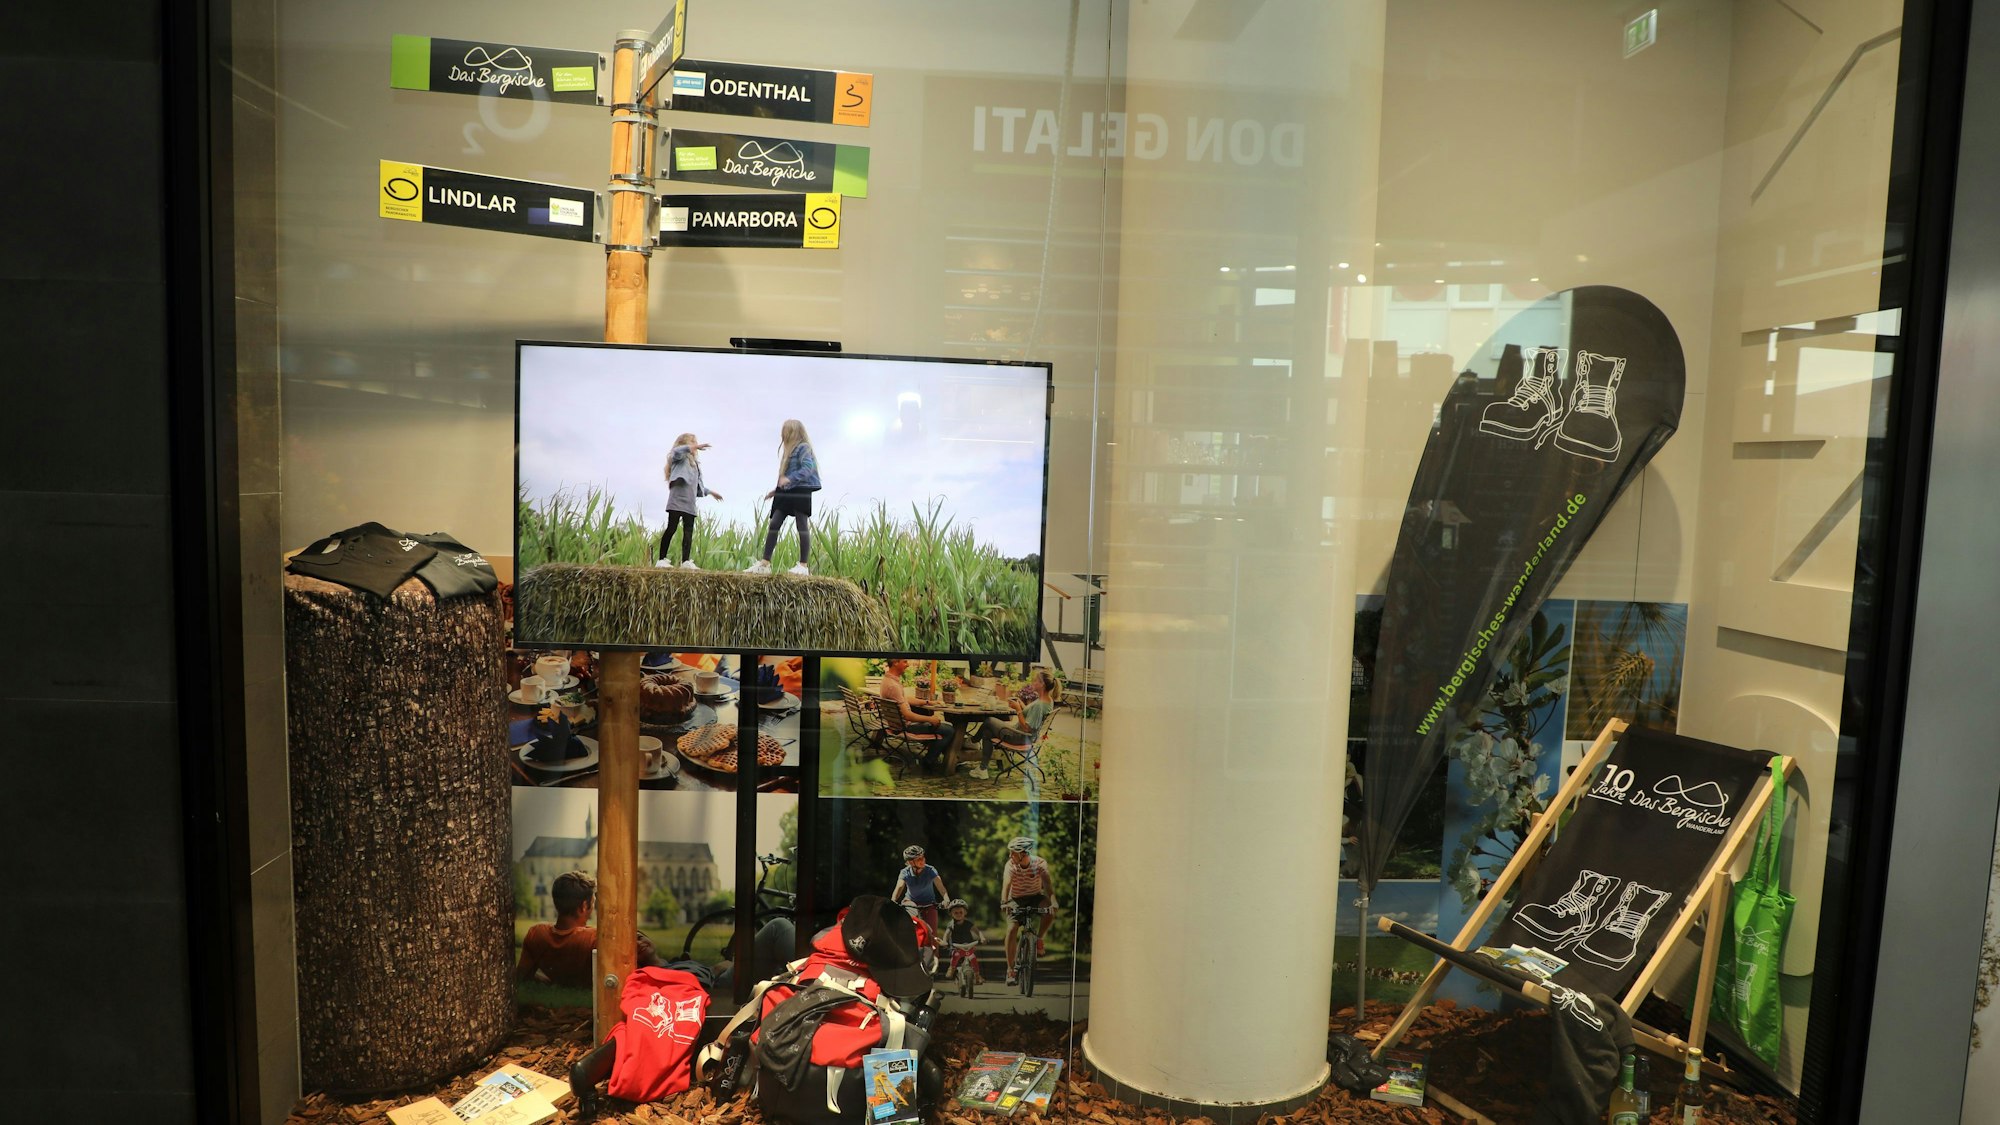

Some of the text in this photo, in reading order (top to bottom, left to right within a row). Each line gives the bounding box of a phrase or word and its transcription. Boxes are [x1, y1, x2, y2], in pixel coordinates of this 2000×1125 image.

[448, 65, 546, 94] Das Bergische
[710, 78, 811, 103] ODENTHAL
[723, 158, 816, 187] Das Bergische
[428, 186, 516, 213] LINDLAR
[692, 211, 798, 228] PANARBORA
[1416, 492, 1587, 736] www.bergisches-wanderland.de
[1603, 764, 1635, 793] 10
[1591, 780, 1732, 830] Jahre Das Bergische
[1685, 822, 1725, 835] WANDERLAND
